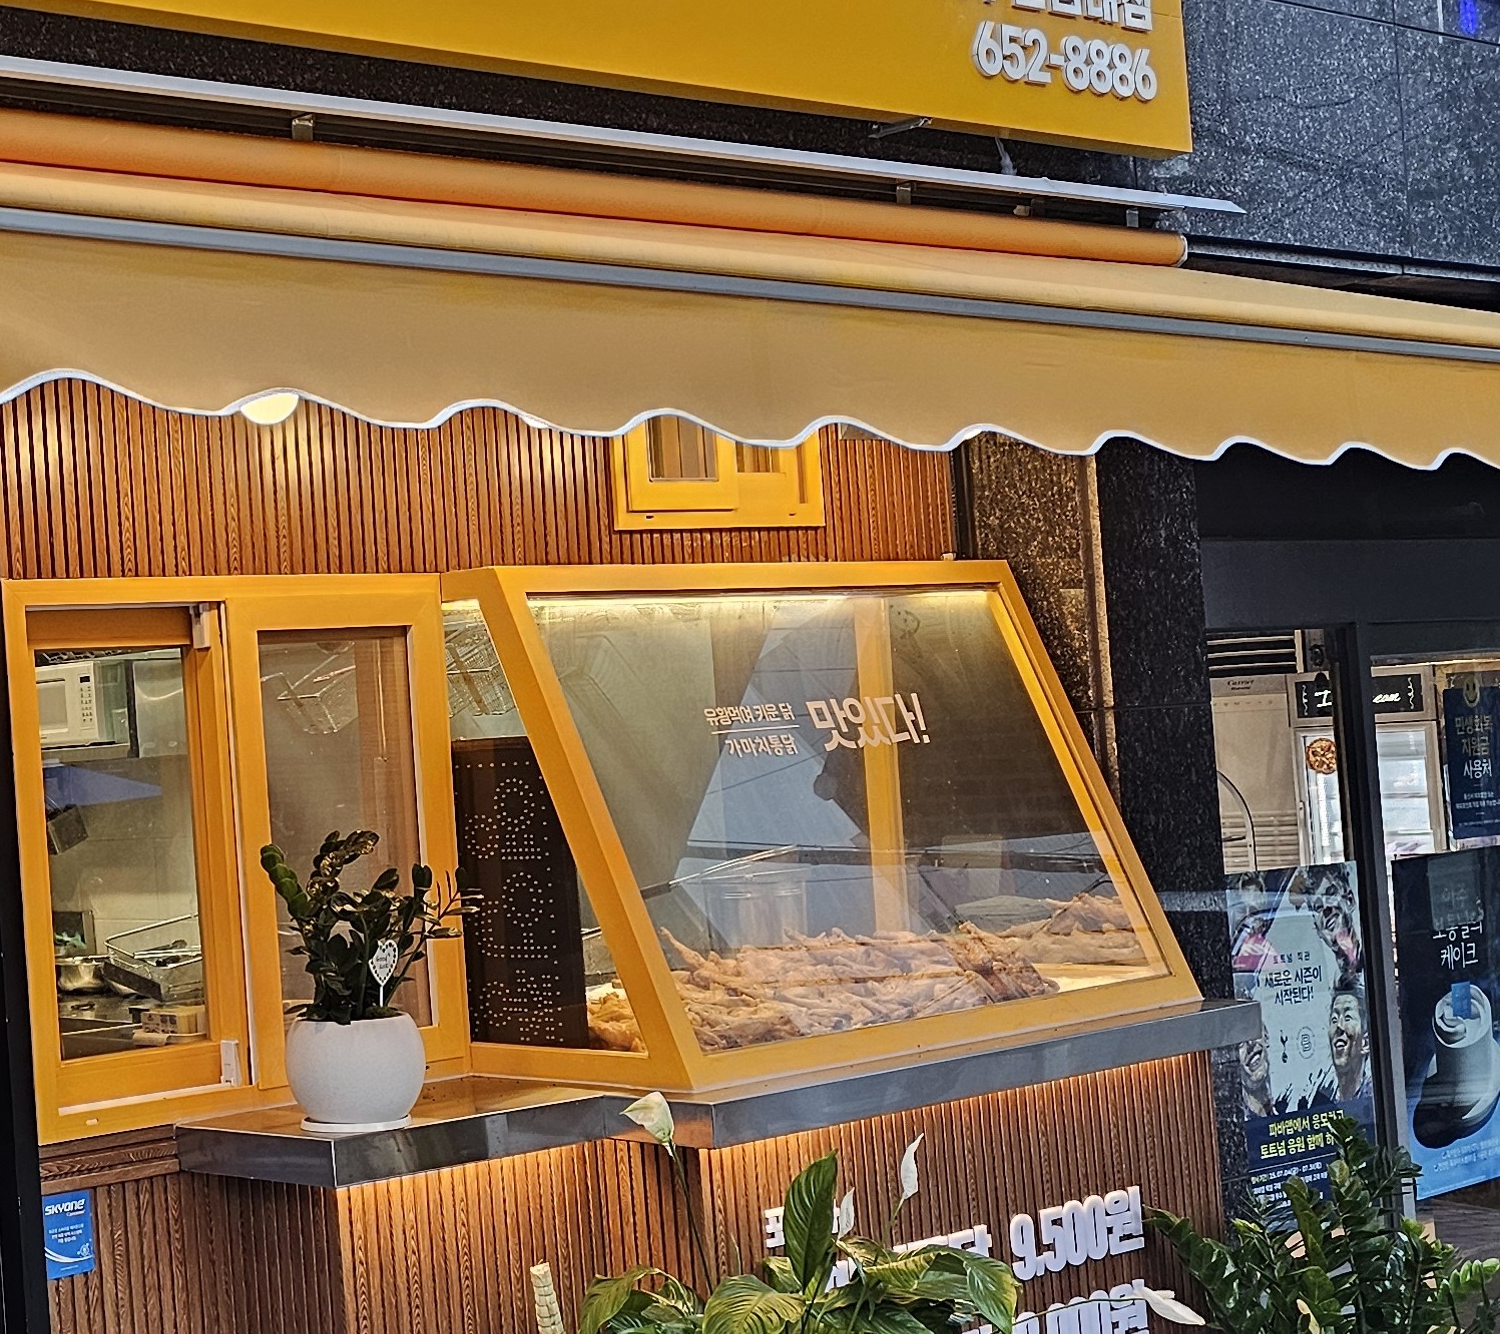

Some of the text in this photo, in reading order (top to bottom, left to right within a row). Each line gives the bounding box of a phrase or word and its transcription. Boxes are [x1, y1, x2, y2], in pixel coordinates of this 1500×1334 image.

[972, 20, 1158, 101] 652-8886
[805, 693, 931, 752] 맛있다!
[725, 733, 799, 758] 가마치통닭
[1463, 758, 1493, 779] 사용처
[1440, 941, 1479, 970] 케이크
[1294, 965, 1322, 984] 시즌이
[1274, 986, 1314, 1006] 시작된다!
[1260, 1139, 1286, 1159] 토트넘
[1287, 1136, 1306, 1155] 응원
[1010, 1186, 1145, 1281] 9,500원
